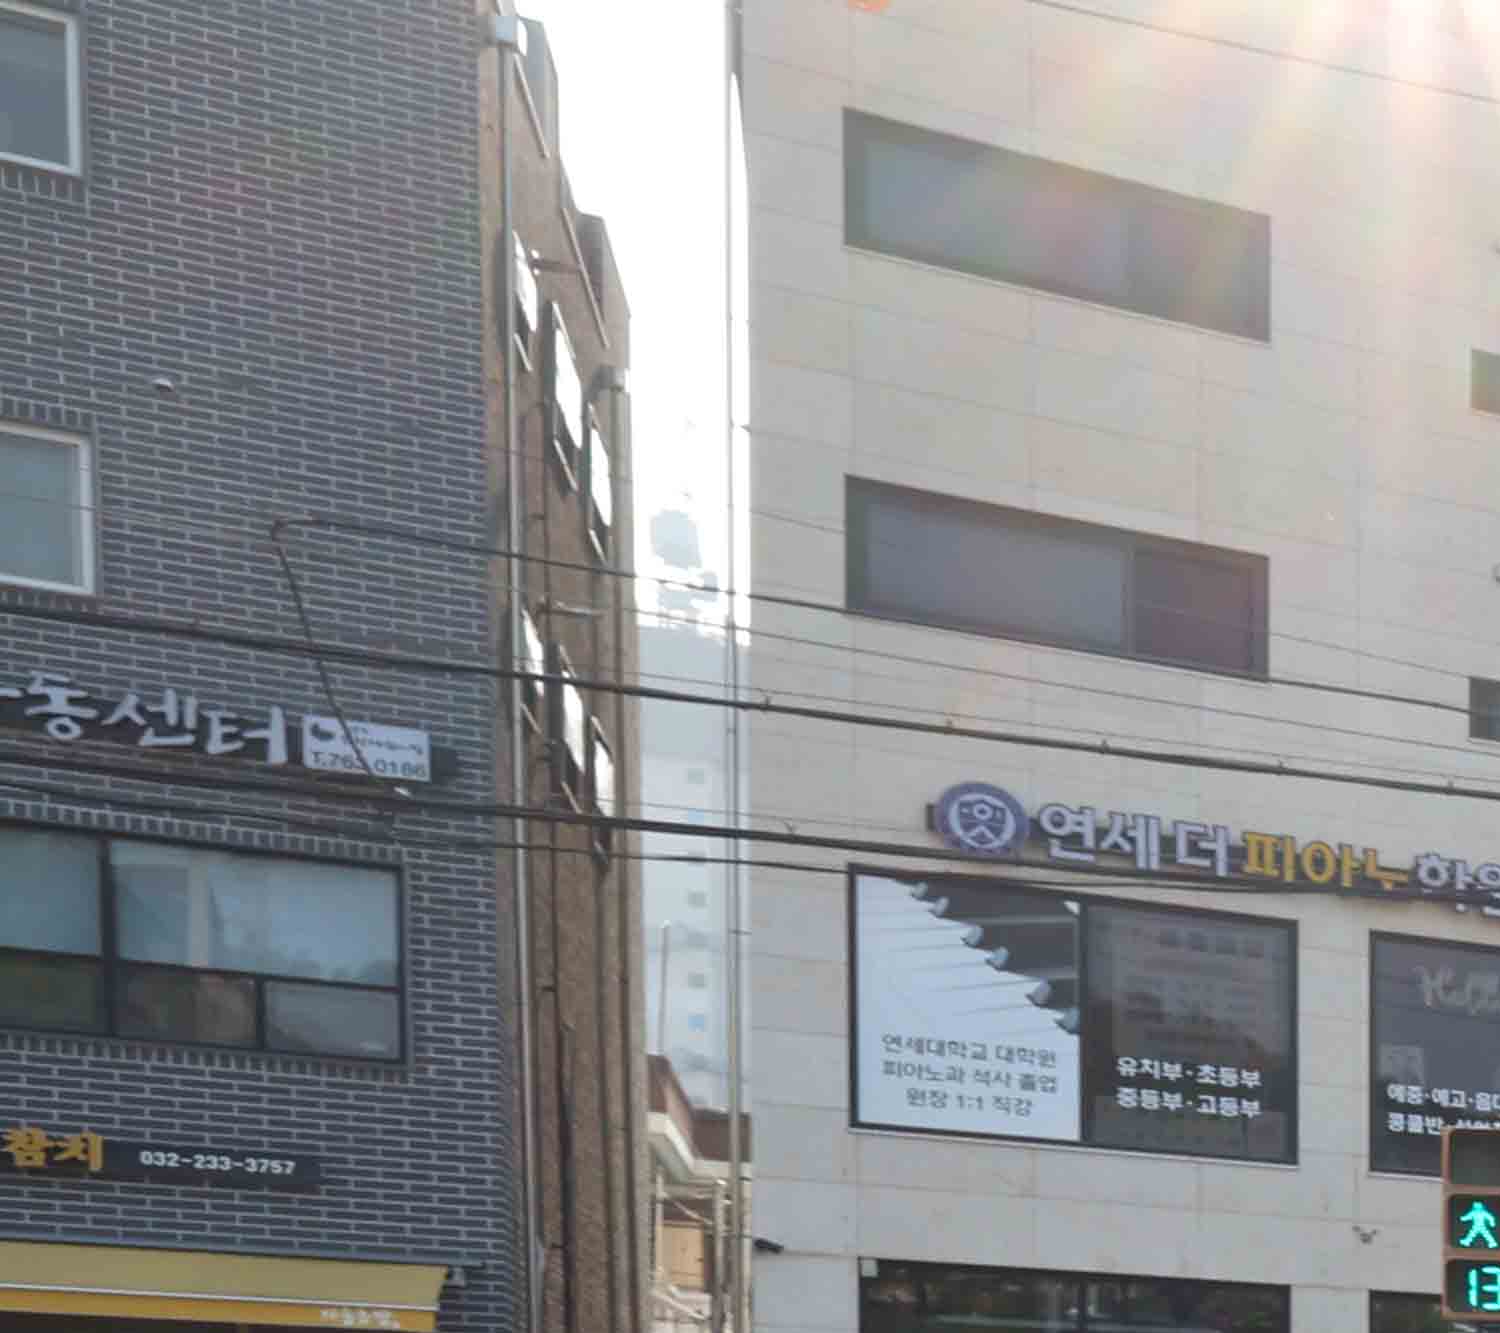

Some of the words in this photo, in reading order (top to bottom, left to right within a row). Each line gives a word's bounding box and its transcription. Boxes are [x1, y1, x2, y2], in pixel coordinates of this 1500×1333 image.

[0, 670, 290, 765] 동센터
[880, 1033, 988, 1062] 연세대학교
[139, 1149, 297, 1176] 032-233-3757
